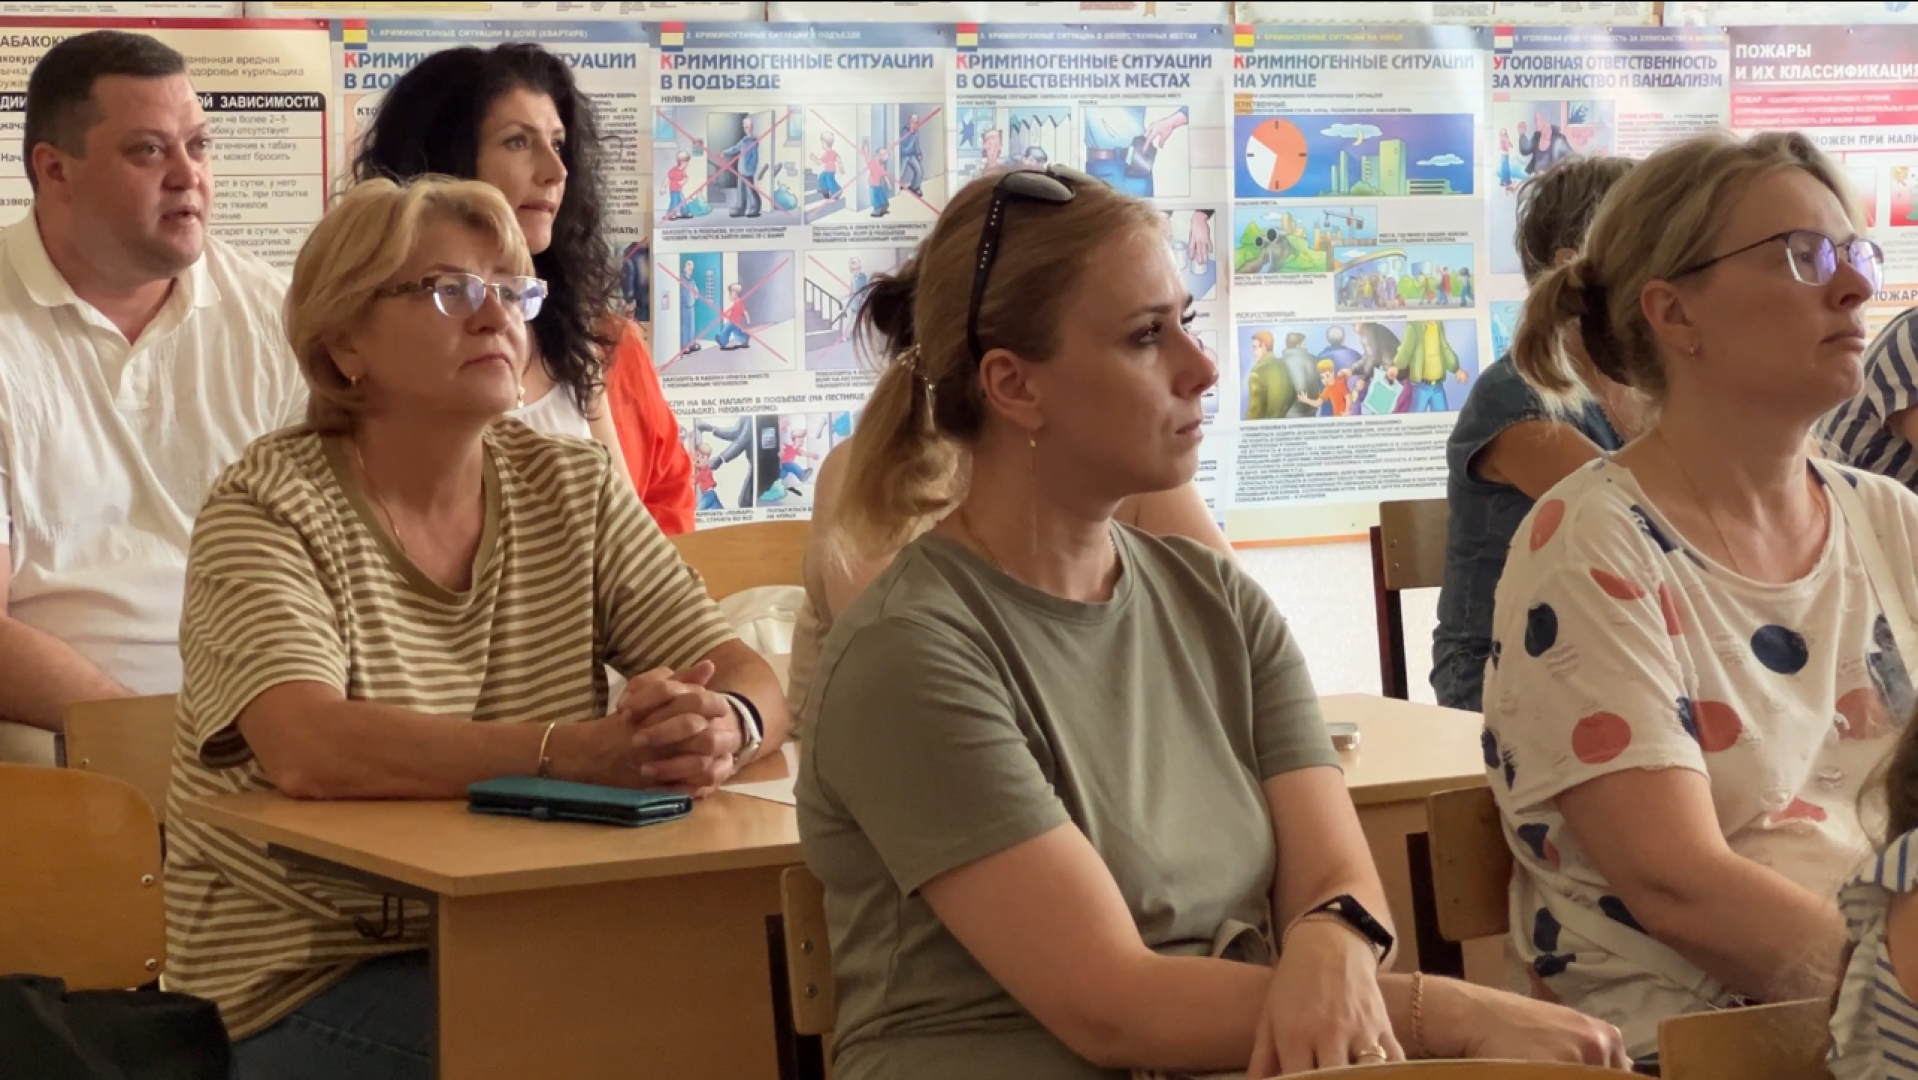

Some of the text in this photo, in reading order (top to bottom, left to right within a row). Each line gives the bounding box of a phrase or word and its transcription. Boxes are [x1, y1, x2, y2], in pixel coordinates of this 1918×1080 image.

[380, 30, 455, 38] КРИМИНОГЕННЫЕ
[458, 30, 502, 38] СИТУАЦИИ
[512, 30, 536, 38] ДОМЕ
[1735, 44, 1811, 59] ПОЖАРЫ
[236, 56, 280, 65] вредная
[660, 53, 934, 70] КРИМИНОГЕННЫЕ СИТУАЦИИ
[956, 54, 1212, 70] КРИМИНОГЕННЫЕ СИТУАЦИИ
[1234, 54, 1475, 70] КРИМИНОГЕННЫЕ СИТУАЦИИ
[1493, 56, 1717, 71] УГОЛОВНАЯ ОТВЕТСТВЕННОСТЬ
[190, 68, 304, 77] здоровье курильщика
[1735, 66, 1747, 80] И
[1752, 65, 1776, 80] ИХ
[344, 73, 357, 89] В
[660, 74, 781, 90] В ПОДЪЕЗДЕ
[956, 73, 1190, 89] В ОБЩЕСТВЕННЫХ МЕСТАХ
[1234, 73, 1317, 89] НА УЛИЦЕ
[1492, 73, 1722, 89] ЗА ХУЛИГАНСТВО И ВАНДАЛИЗМ
[220, 95, 319, 109] ЗАВИСИМОСТИ
[239, 115, 267, 123] более
[237, 127, 290, 136] отсутствует
[1860, 134, 1884, 145] ПРИ
[223, 151, 290, 161] может бросить
[276, 179, 297, 187] него
[702, 399, 717, 407] ВАС
[719, 398, 753, 406] НАПАЛИ
[764, 396, 806, 404] ПОДЪЕЗДЕ
